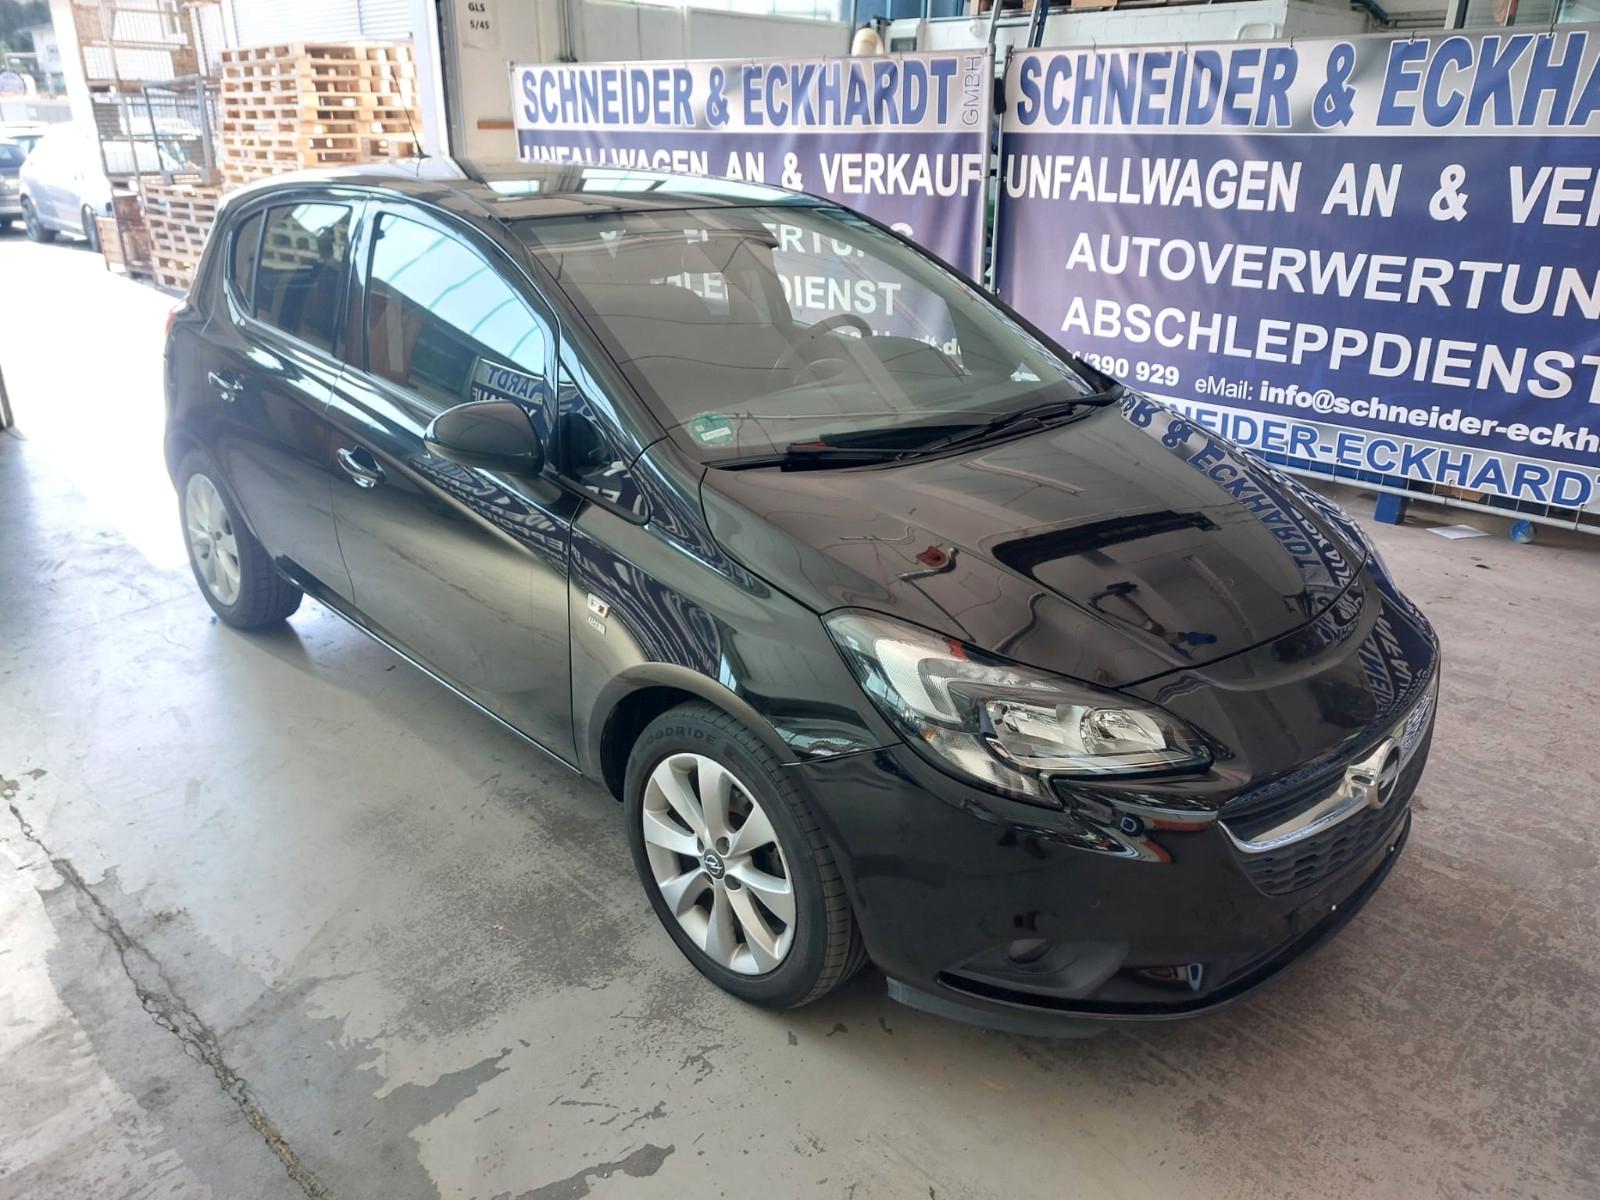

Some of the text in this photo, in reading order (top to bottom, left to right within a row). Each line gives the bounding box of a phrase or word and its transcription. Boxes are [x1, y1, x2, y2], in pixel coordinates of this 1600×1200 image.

[468, 2, 486, 12] GLS
[521, 56, 981, 128] SCHNEIDER & ECKHARDT GMBH
[1016, 46, 1300, 128] SCHNEIDER
[1313, 41, 1358, 130] &
[726, 151, 765, 184] AN
[781, 152, 804, 192] &
[820, 153, 983, 197] VERKAUF
[1005, 153, 1302, 213] UNFALLWAGEN
[1321, 161, 1402, 218] AN
[1429, 163, 1469, 223] &
[1065, 232, 1600, 320] AUTOVERWERTUN
[1136, 361, 1180, 387] 929
[1195, 375, 1254, 401] eMail:
[1259, 379, 1600, 454] info@schneider-eckh
[646, 726, 716, 745] OODRIDE
